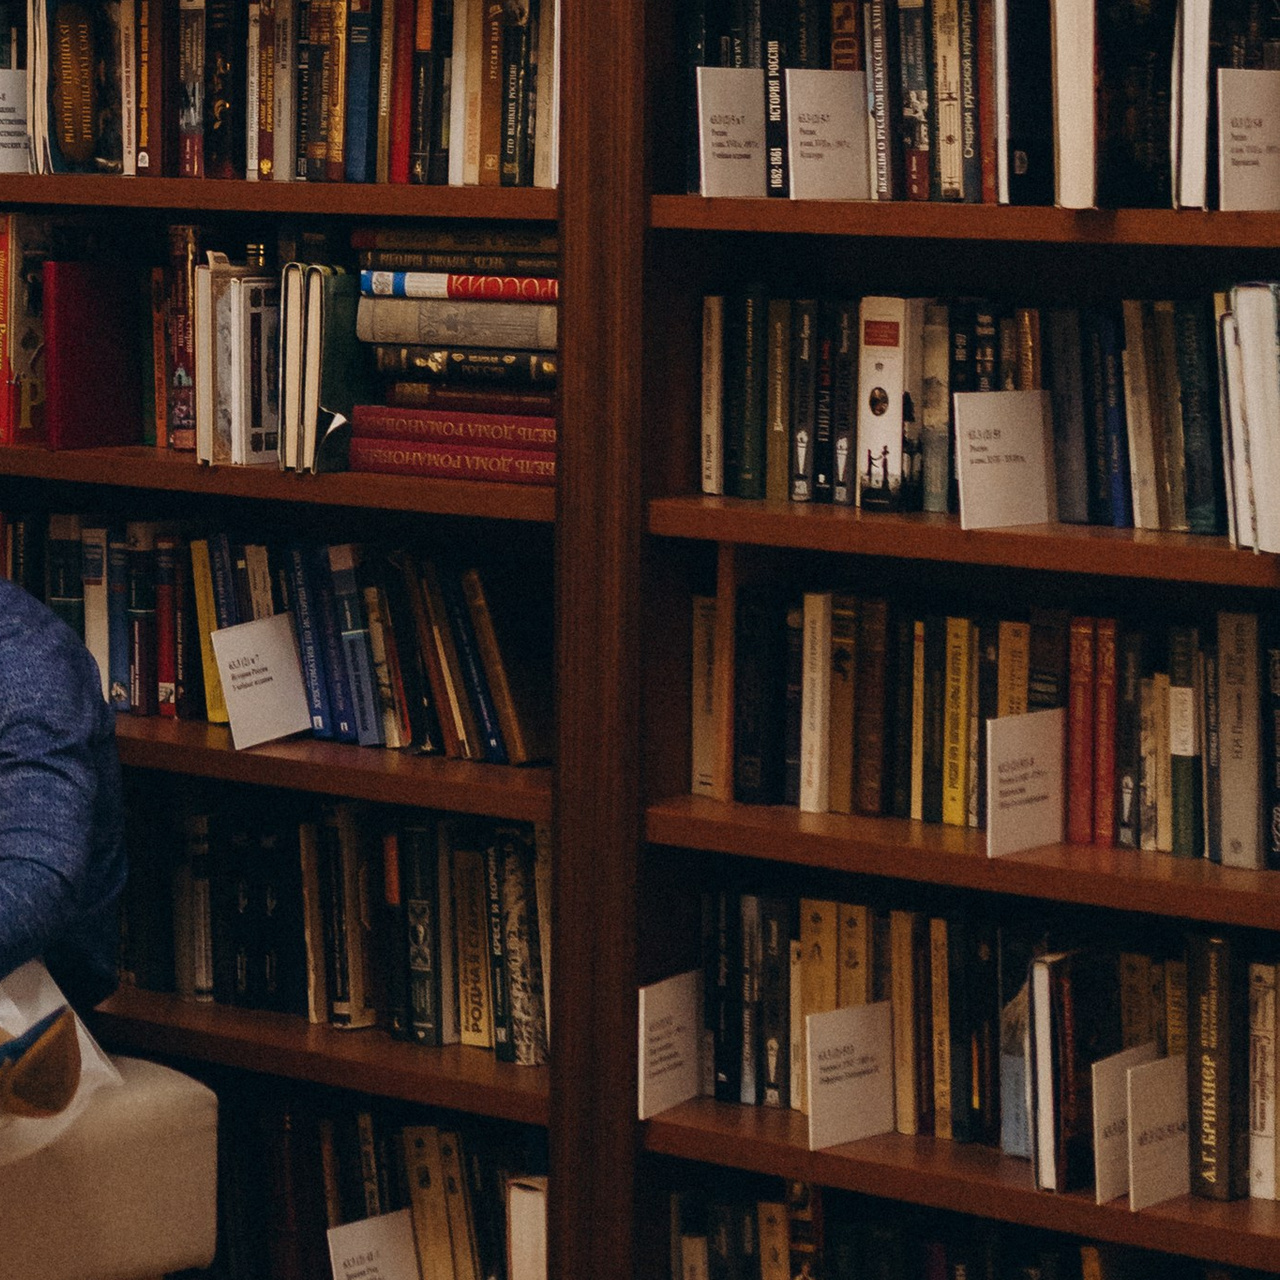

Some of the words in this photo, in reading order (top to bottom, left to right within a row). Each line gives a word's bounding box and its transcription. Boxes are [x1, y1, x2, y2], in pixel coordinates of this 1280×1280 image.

[871, 4, 881, 31] XVIII
[959, 0, 974, 56] культуры
[767, 40, 779, 77] РОССИИ
[871, 35, 883, 92] ИСКУССТВЕ
[380, 62, 389, 117] ГУБЕРНАТОРЫ
[508, 63, 517, 99] РОССИЯН
[961, 58, 975, 109] русской
[507, 101, 516, 136] ВЕЛИКИХ
[768, 80, 781, 121] ИСТОРИЯ
[873, 94, 885, 141] РУССКОМ
[876, 142, 886, 151] О
[962, 112, 975, 159] Очерки
[770, 146, 782, 188] 1682-1861
[877, 153, 888, 194] БЕСЕДЫ
[451, 274, 550, 301] РОССИЯ
[359, 416, 465, 437] РОМАНОВЫХ
[468, 422, 516, 441] ДОМА
[516, 426, 557, 444] БЕЛЬ
[357, 449, 463, 471] РОМАНОВЫХ
[465, 455, 514, 473] ДОМА
[515, 459, 556, 477] БЕЛЬ
[486, 847, 499, 901] КОРОНА
[489, 904, 500, 914] И
[491, 917, 503, 957] КРЕСТ
[468, 954, 484, 1034] РОДНАЯ
[1200, 1054, 1217, 1184] А.Г.БРИКНЕР
